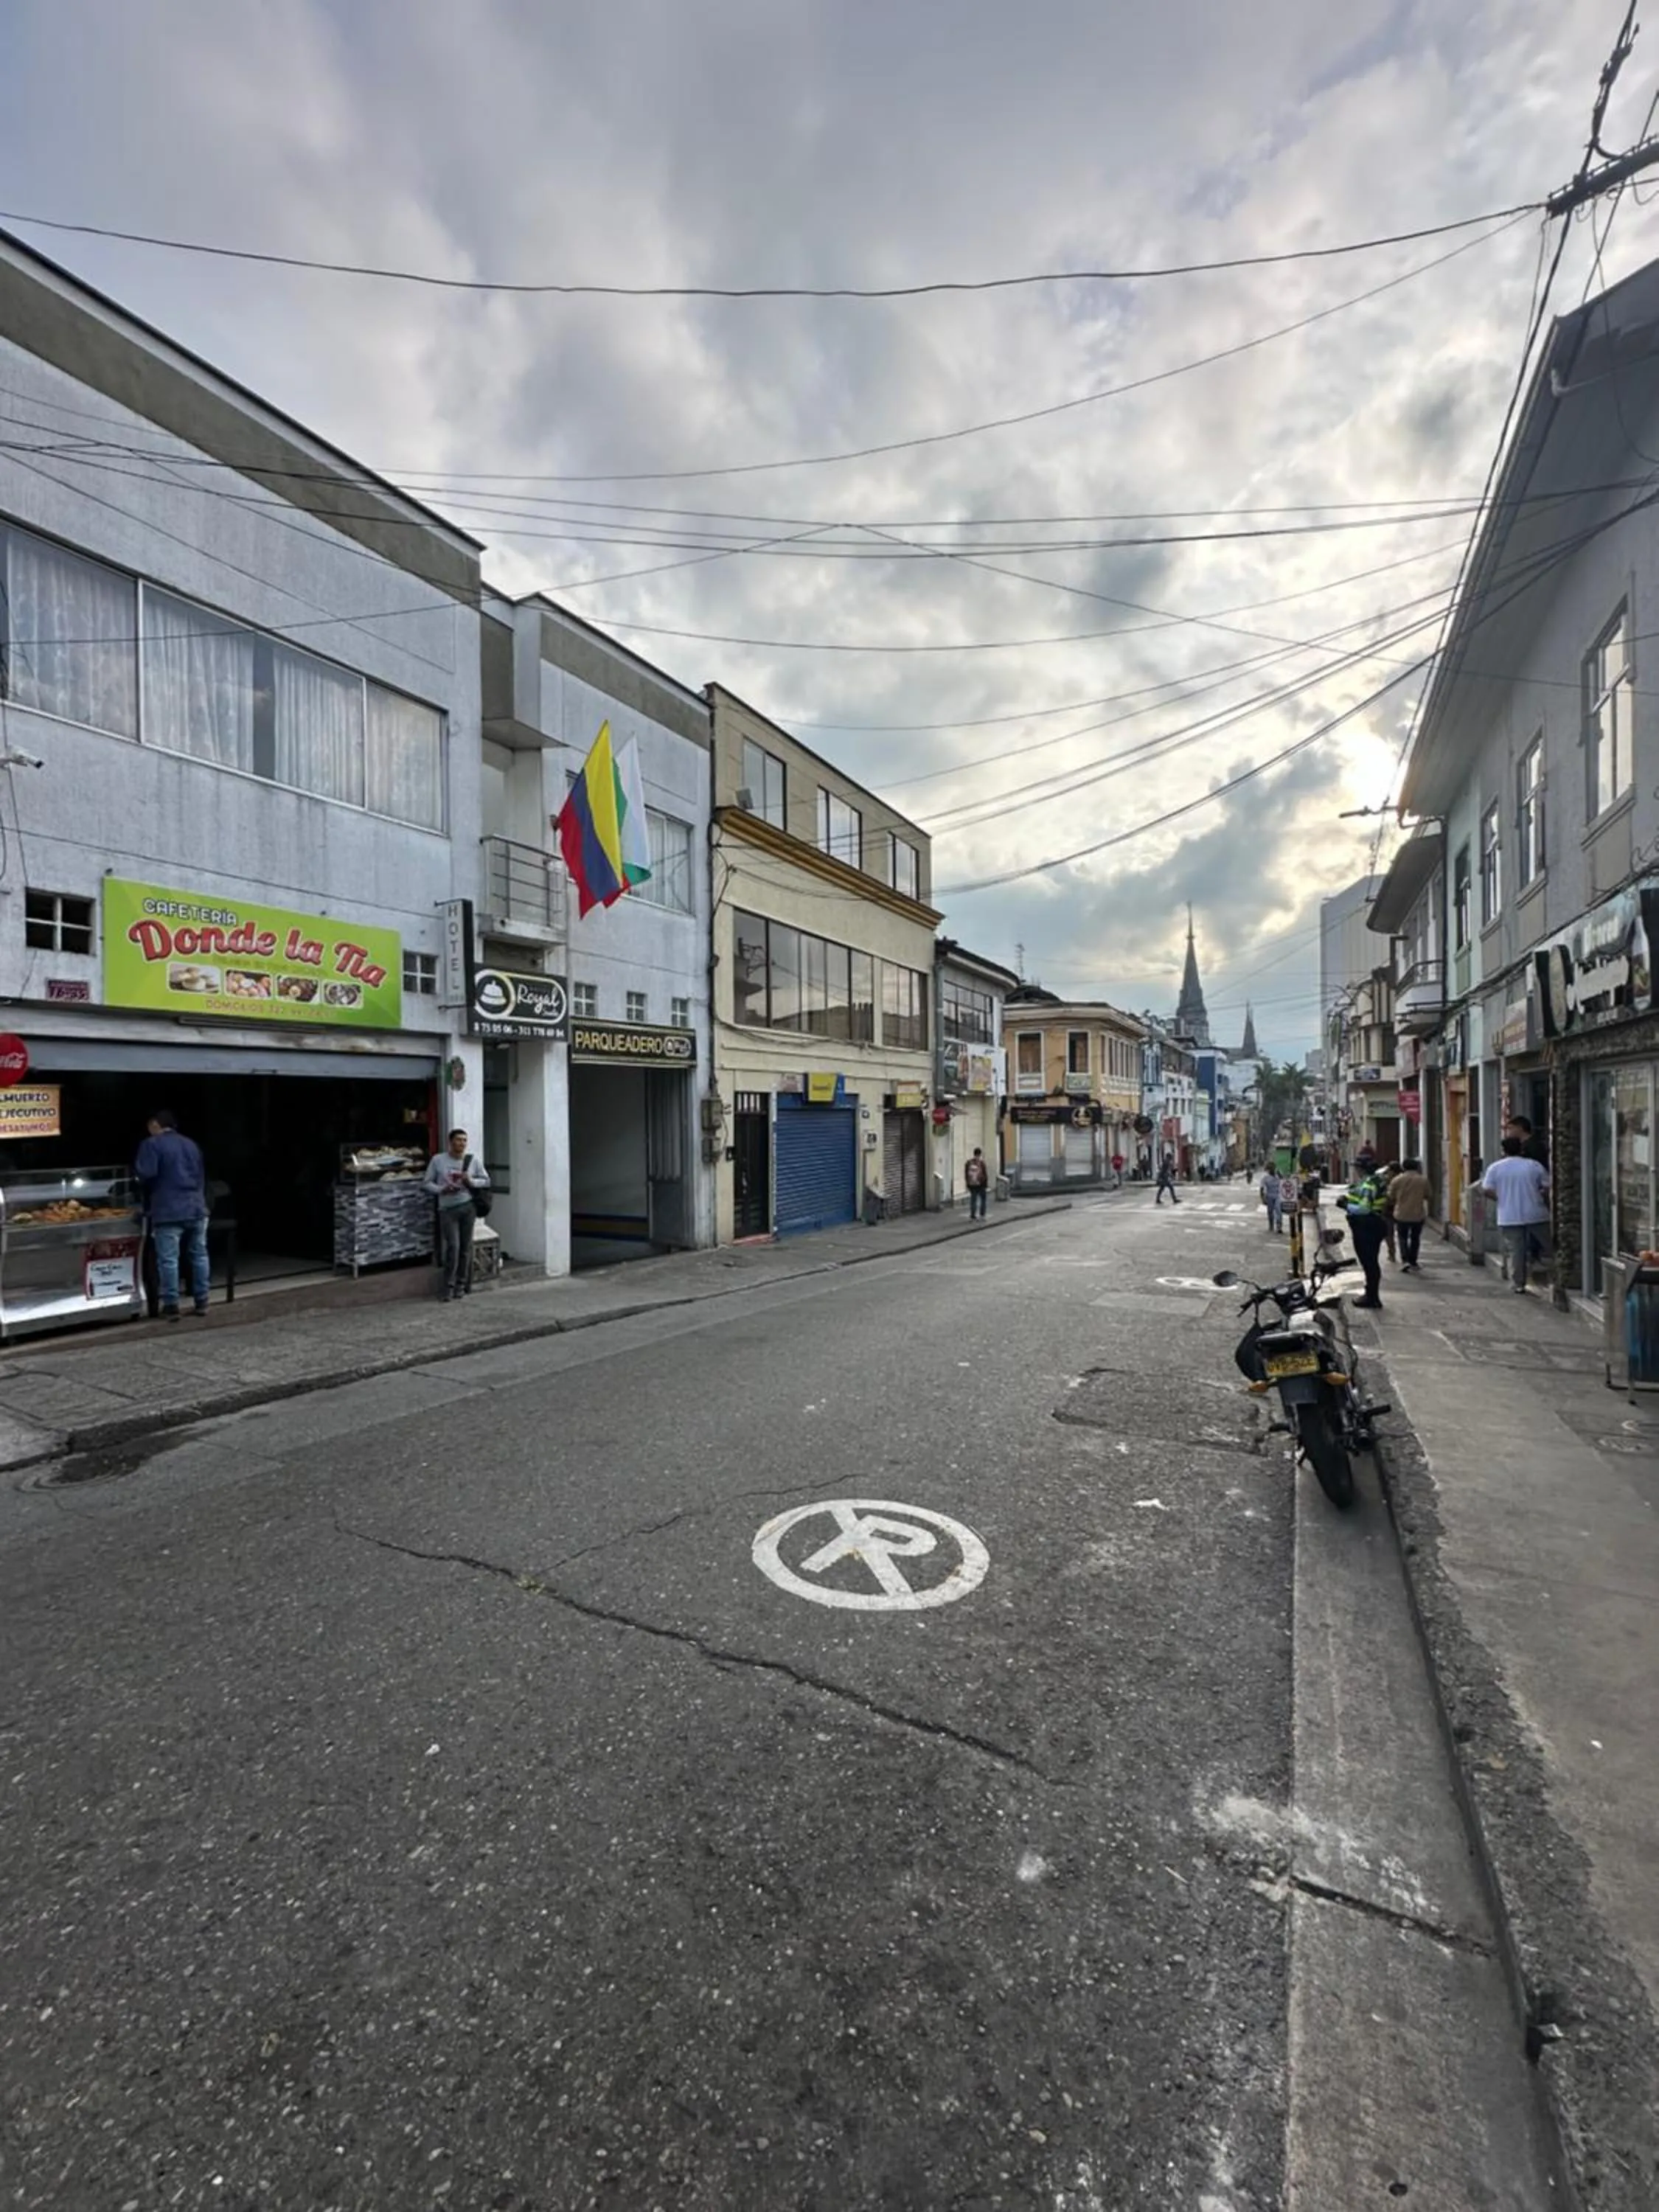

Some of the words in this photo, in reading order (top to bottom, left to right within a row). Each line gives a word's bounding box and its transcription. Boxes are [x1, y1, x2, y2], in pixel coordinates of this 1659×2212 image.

[128, 919, 277, 961] Donde
[285, 928, 324, 966] la
[448, 904, 461, 990] HOTEL
[518, 983, 560, 1014] Royal
[575, 1030, 663, 1054] PARQUEADERO
